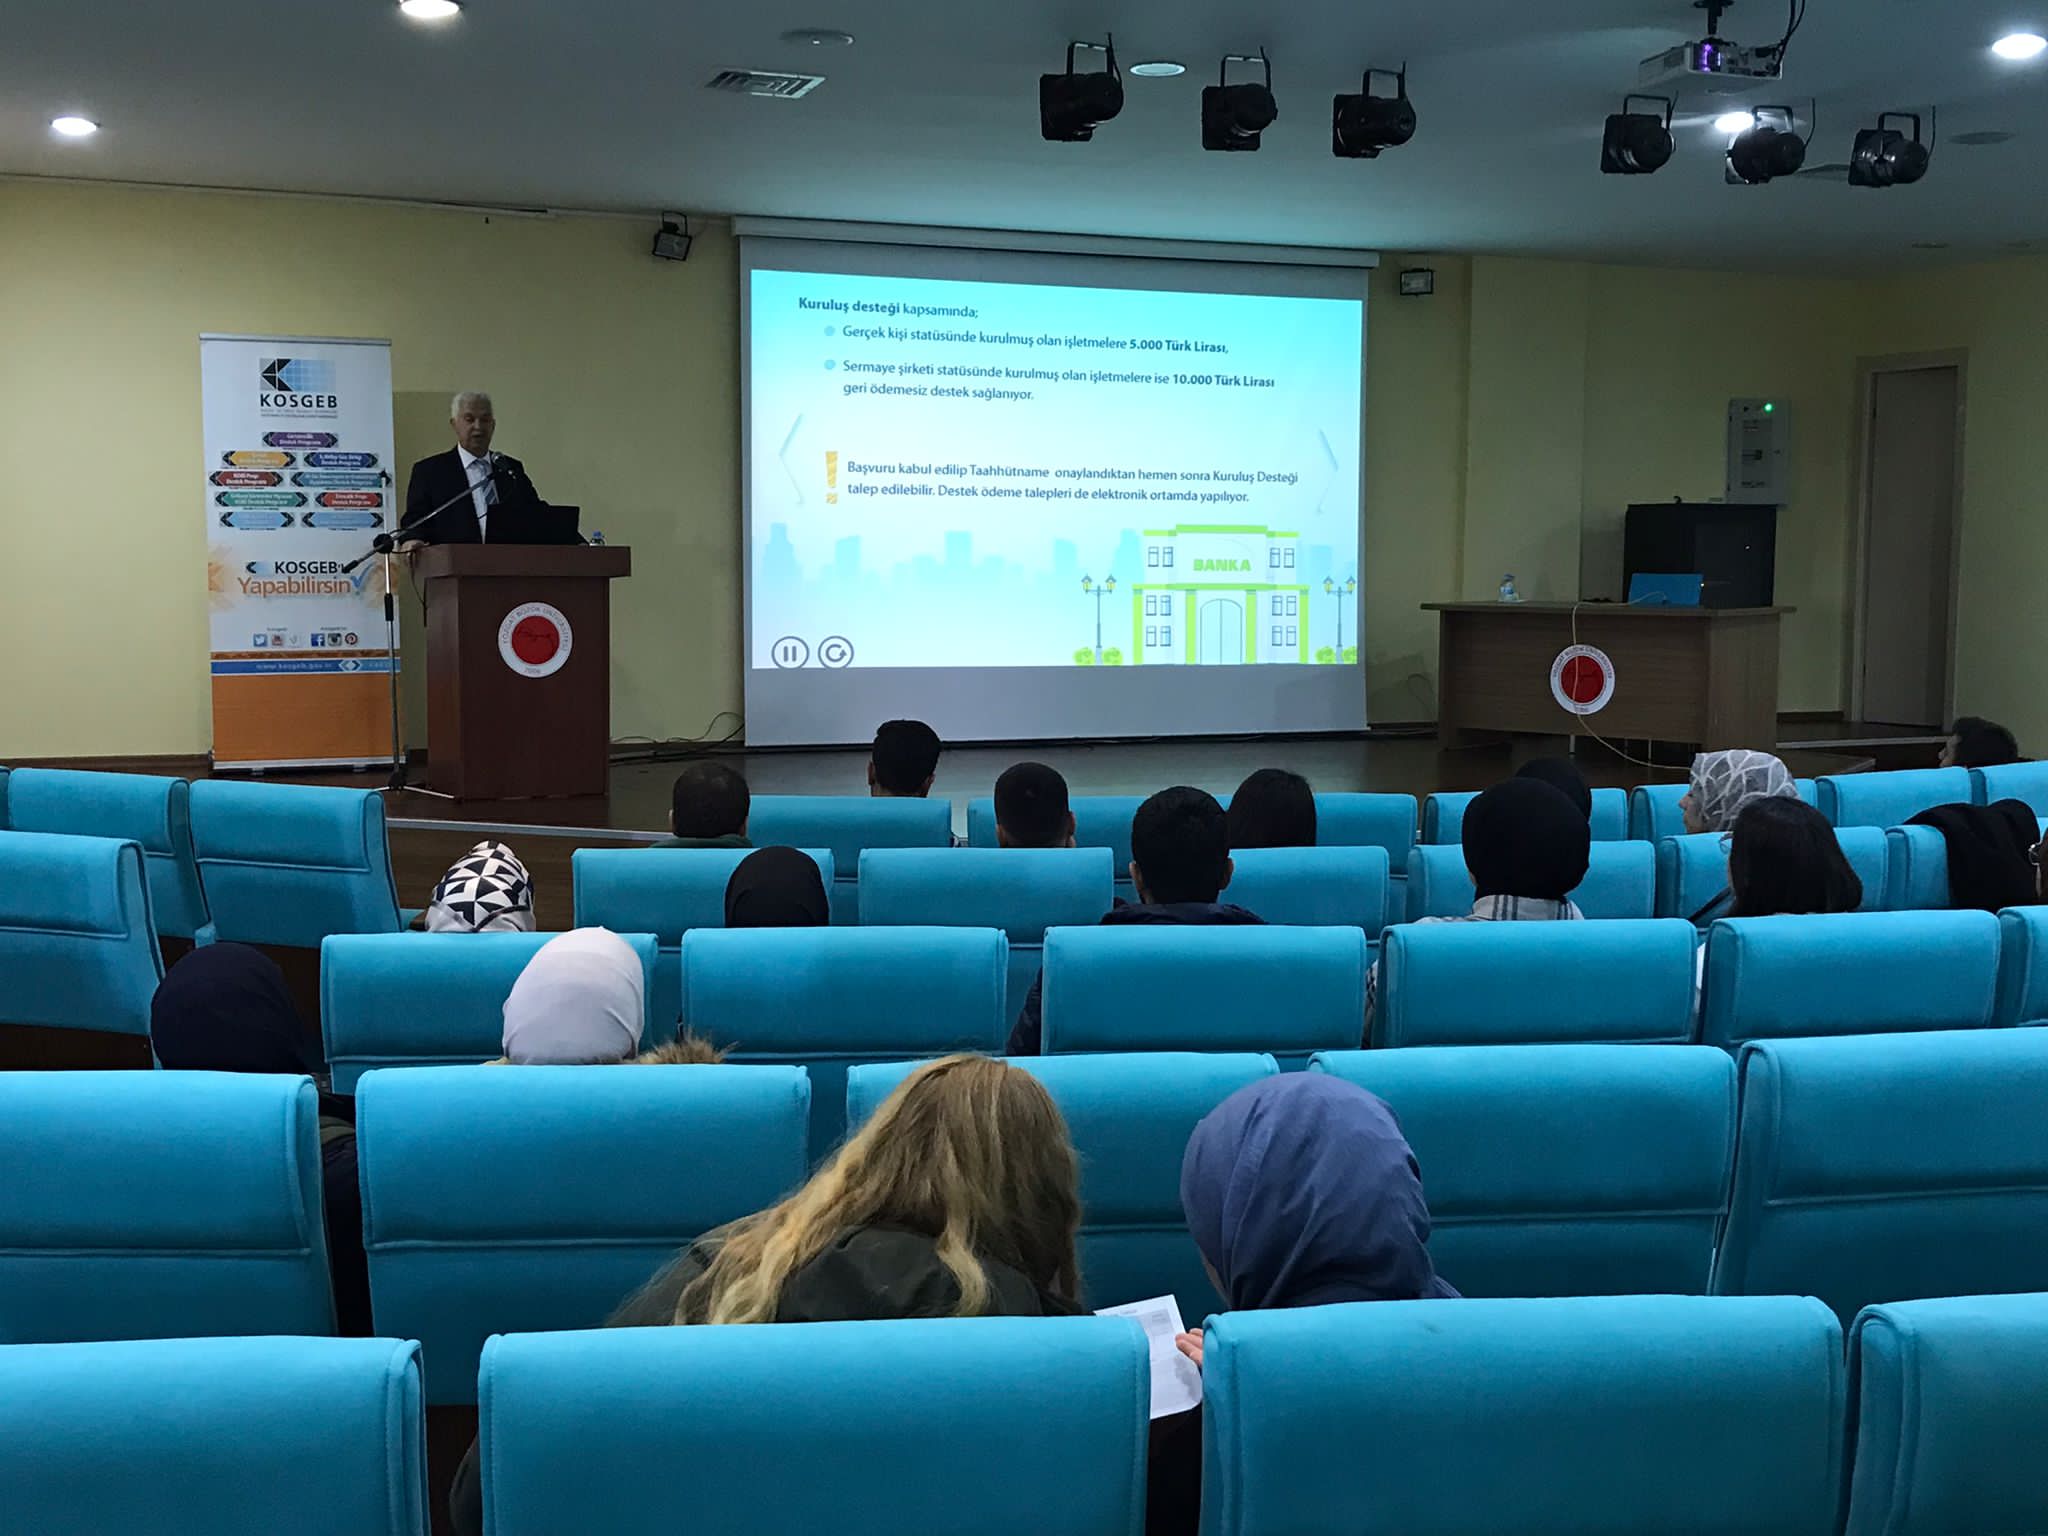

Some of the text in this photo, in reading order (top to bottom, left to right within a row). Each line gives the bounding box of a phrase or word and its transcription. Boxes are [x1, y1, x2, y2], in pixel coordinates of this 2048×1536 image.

[798, 297, 979, 319] Kuruluş desteği kapsamında;
[842, 324, 1230, 355] Gerçek kişi statüsünde kurulmuş olan işletmelere 5.000 Türk Lirası,
[842, 360, 1275, 388] Sermaye şirketi statüsünde kurulmuş olan işletmelere ise 10.000 Türk Lirası
[260, 393, 337, 408] KOSGEB
[843, 384, 1035, 402] geri ödemesiz destek sağlanıyor.
[847, 461, 1299, 486] Başvuru kabul edilip Taahhütname onaylandıktan hemen sonra Kuruluş Desteği
[847, 484, 1249, 504] talep edilebilir. Destek ödeme talepleri de elektronik ortamda yapılıyor.
[1193, 559, 1252, 571] BANKA
[238, 576, 351, 598] Yapabilirsin
